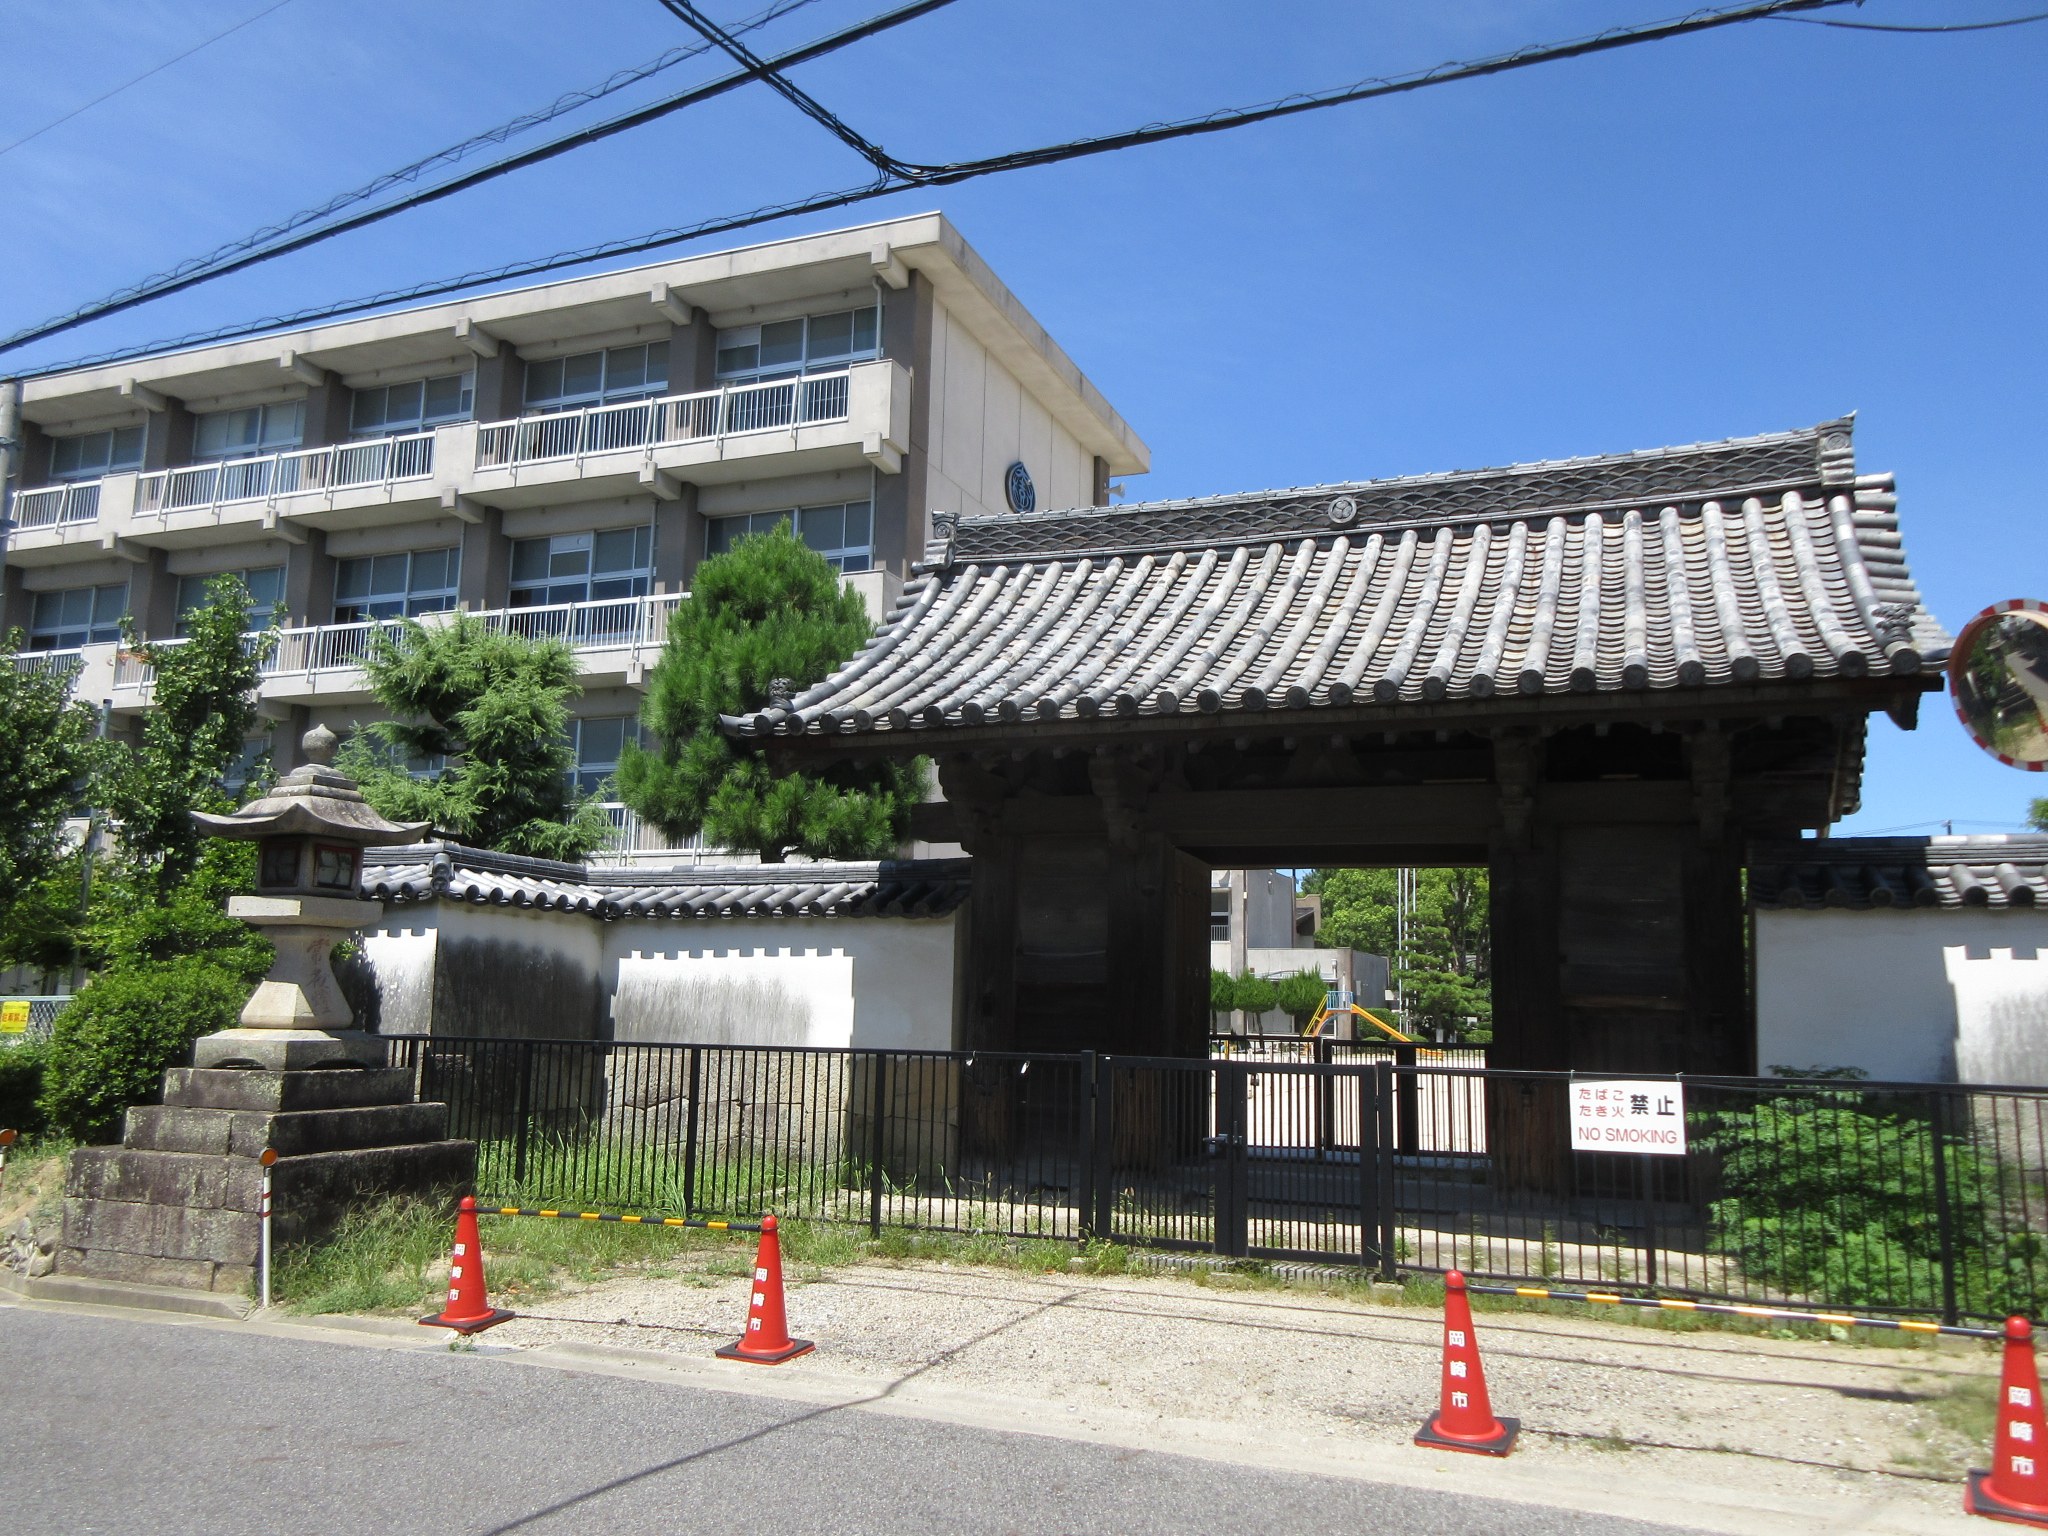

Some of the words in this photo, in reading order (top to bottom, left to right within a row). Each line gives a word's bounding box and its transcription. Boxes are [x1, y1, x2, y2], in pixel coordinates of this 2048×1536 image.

[1578, 1088, 1624, 1101] たばこ
[1579, 1105, 1625, 1118] たき火
[1630, 1094, 1675, 1116] 禁止
[1578, 1127, 1601, 1141] NO
[1605, 1128, 1678, 1144] SMOKING
